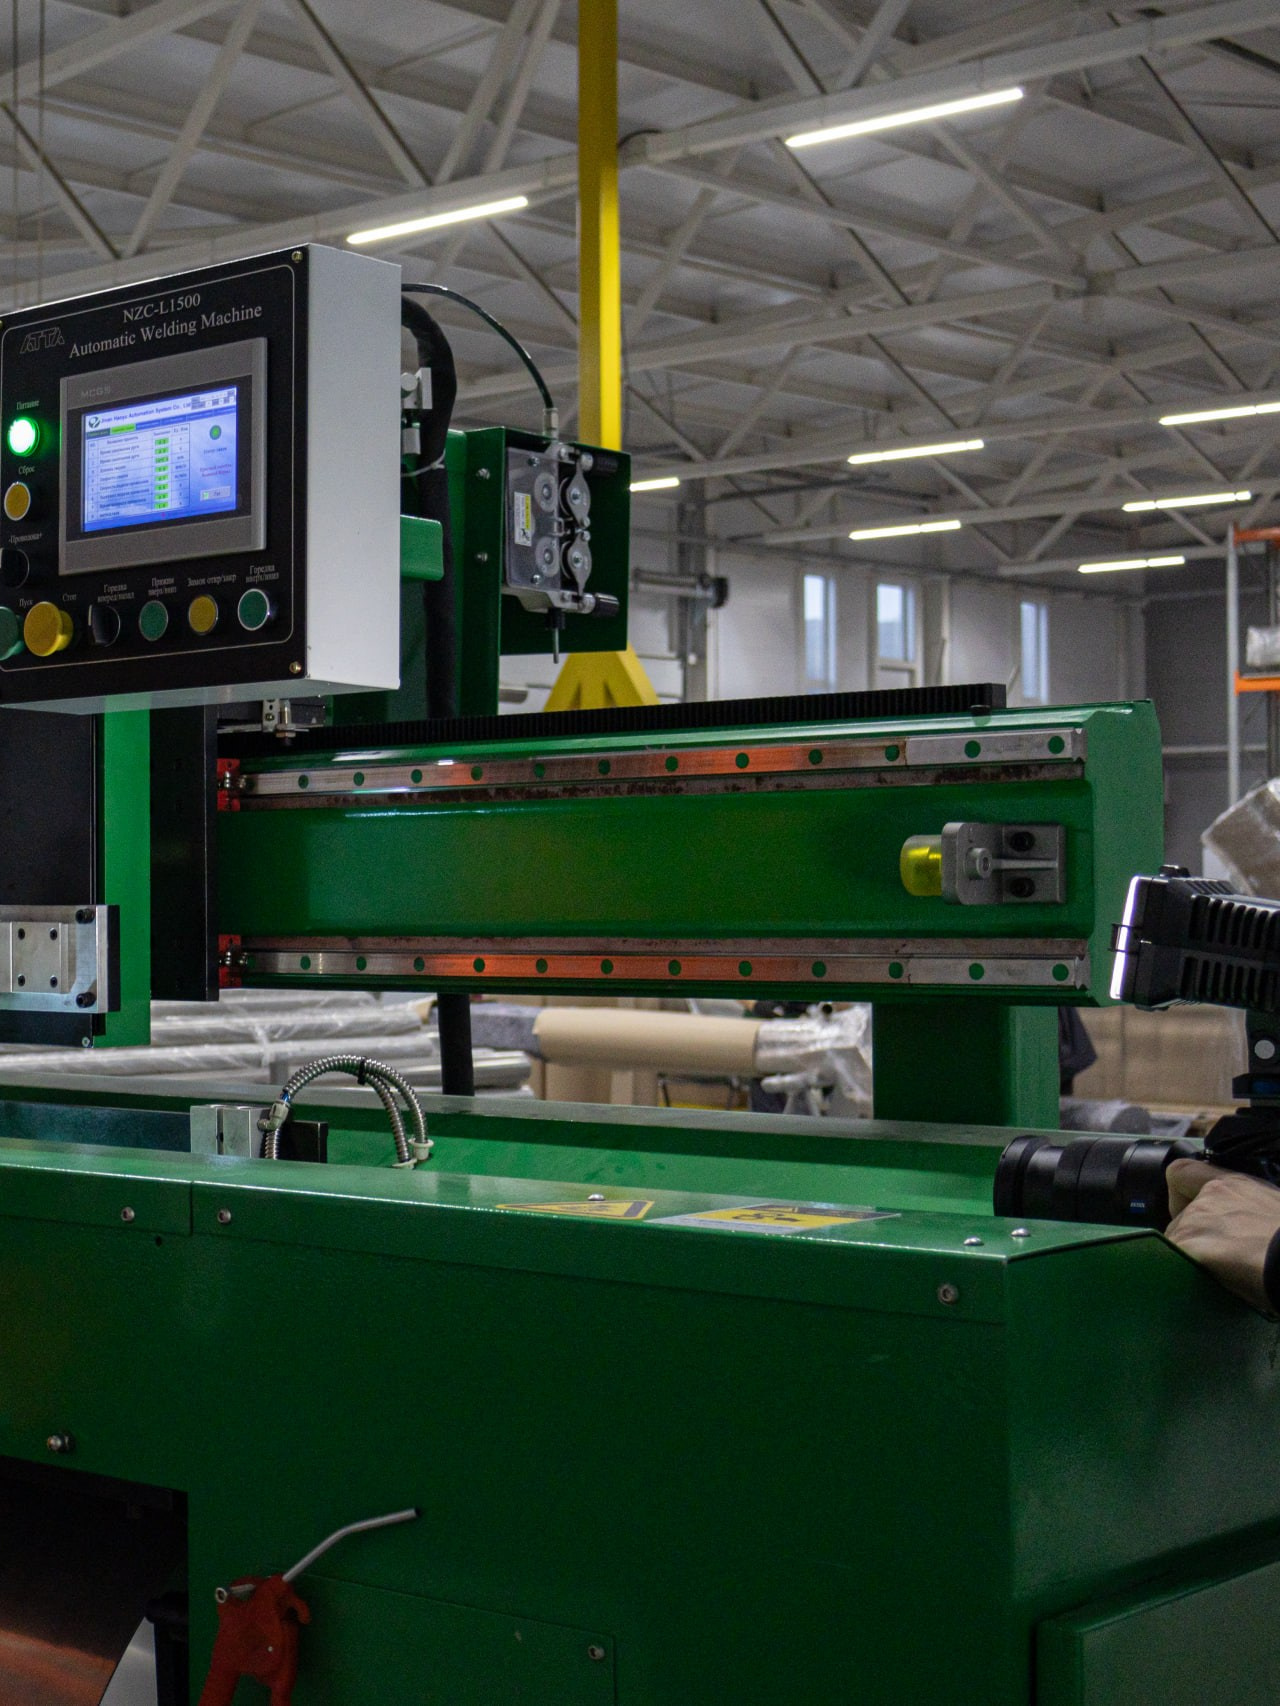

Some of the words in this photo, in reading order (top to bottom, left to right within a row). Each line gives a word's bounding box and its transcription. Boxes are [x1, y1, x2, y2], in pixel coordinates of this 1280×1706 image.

[123, 293, 201, 323] NZC-L1500
[69, 331, 136, 359] Automatic
[140, 317, 197, 341] Welding
[201, 304, 263, 330] Machine
